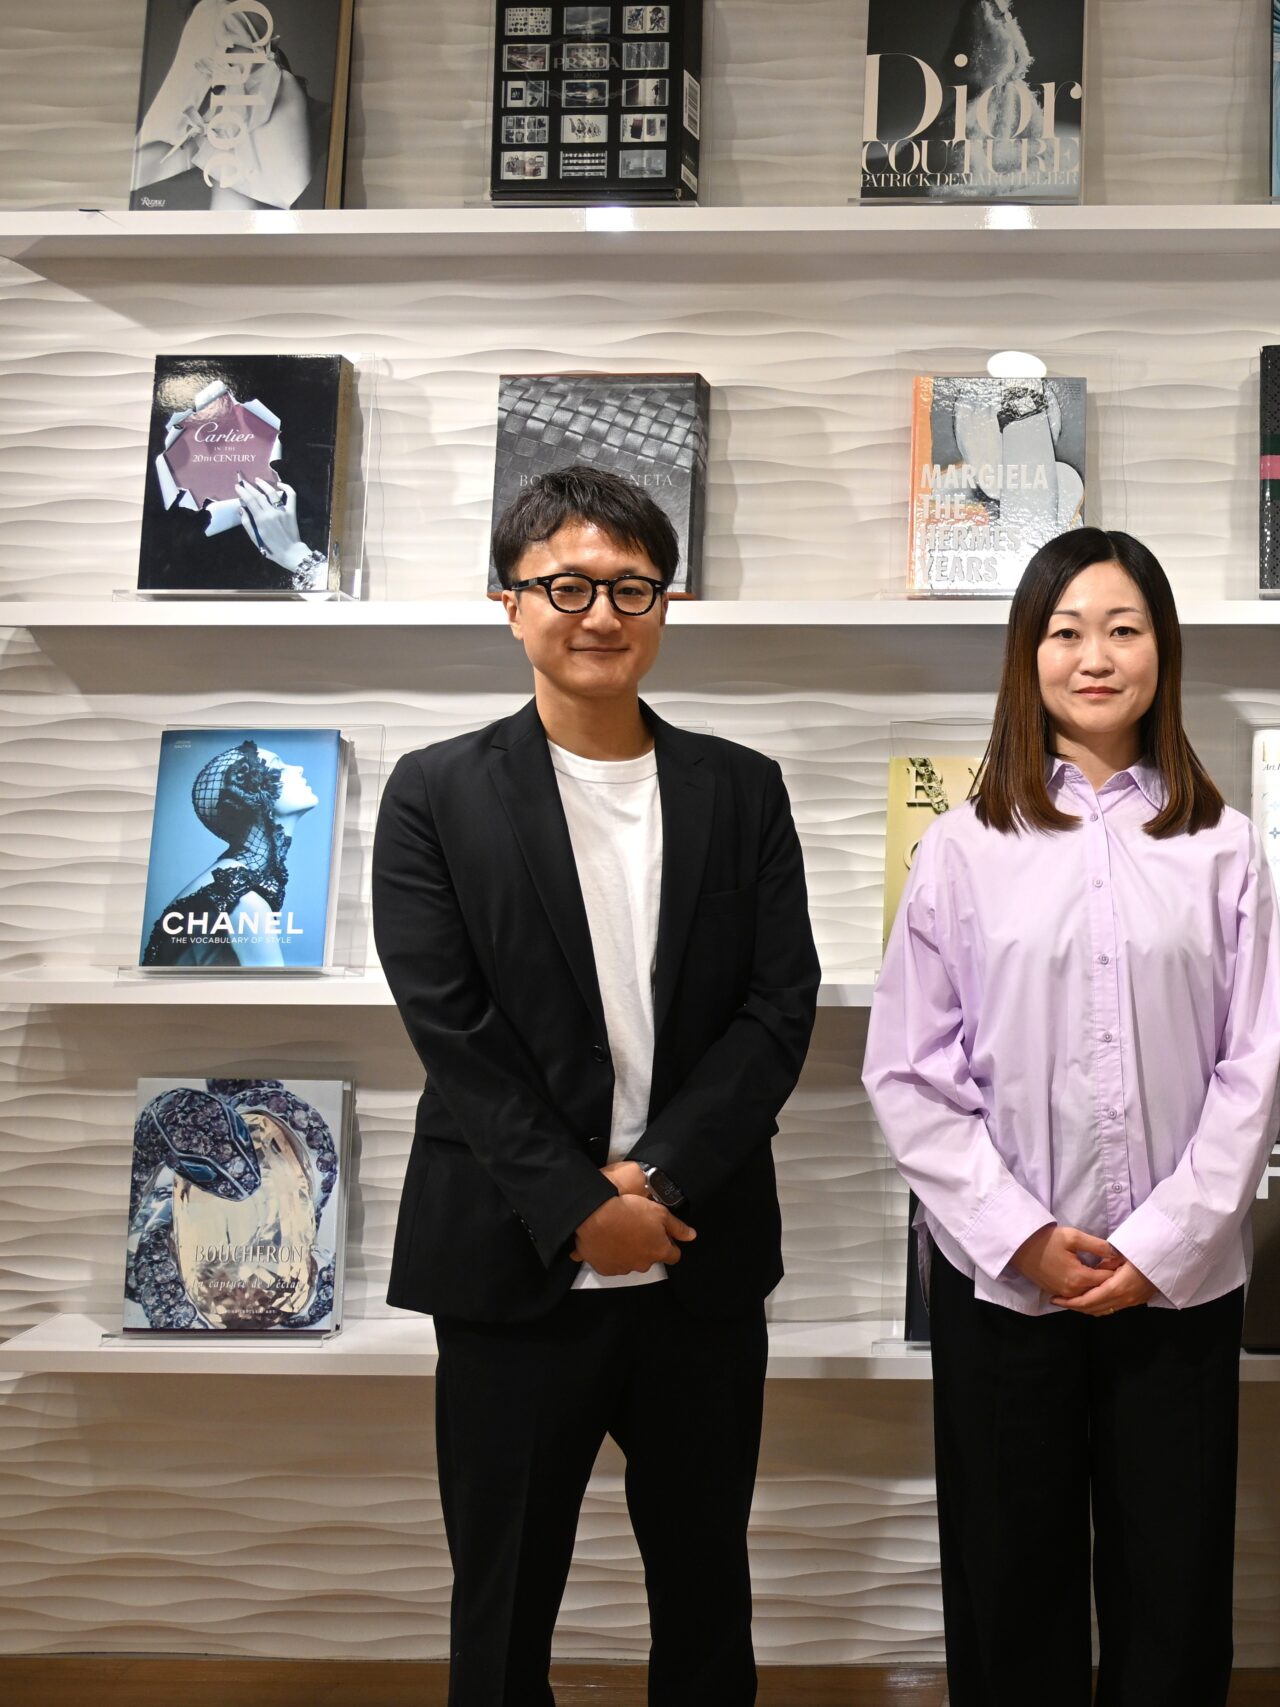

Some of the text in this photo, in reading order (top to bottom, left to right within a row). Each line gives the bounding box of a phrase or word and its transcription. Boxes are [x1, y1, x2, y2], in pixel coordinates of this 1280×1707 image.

[553, 57, 621, 69] PRADA
[862, 53, 1083, 142] Dior
[861, 138, 1080, 175] COUTURE
[860, 171, 1079, 188] PATRICK DEMARCHELIER
[194, 421, 256, 443] Cartier
[213, 454, 257, 462] CENTURY
[920, 463, 1049, 489] MARGIELA
[918, 494, 966, 520] THE
[918, 555, 998, 583] YEARS
[162, 911, 304, 935] CHANEL
[171, 936, 292, 944] THE VOCABULARY OF STYLE
[195, 1245, 303, 1263] BOUCHERON
[208, 1279, 246, 1292] capture
[251, 1278, 263, 1289] de
